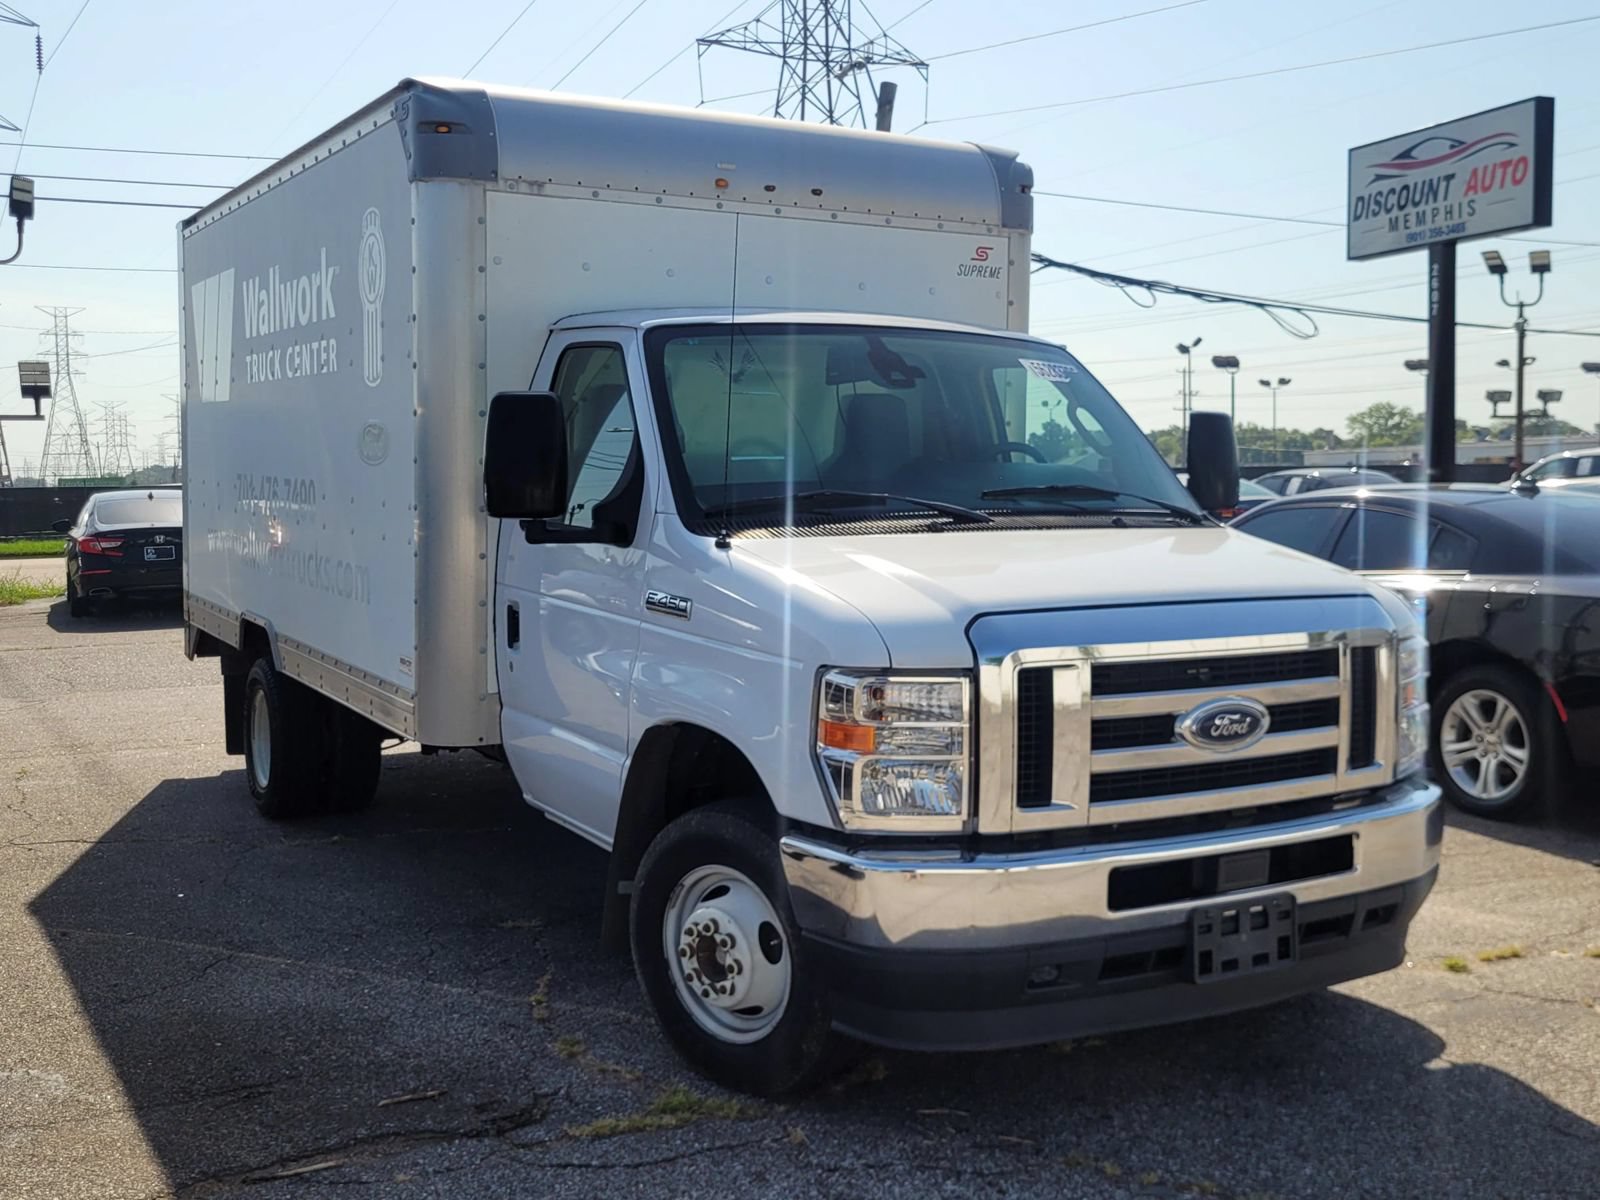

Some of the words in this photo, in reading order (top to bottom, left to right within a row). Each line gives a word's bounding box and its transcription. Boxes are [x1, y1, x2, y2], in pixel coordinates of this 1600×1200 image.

[1353, 173, 1456, 222] DISCOUNT
[1464, 156, 1528, 196] AUTO
[1388, 199, 1477, 232] MEMPHIS
[957, 264, 1002, 279] SUPREME
[243, 247, 336, 339] Wallwork
[245, 349, 282, 384] TRUCK
[286, 338, 337, 377] CENTER
[1211, 714, 1251, 737] Ford
